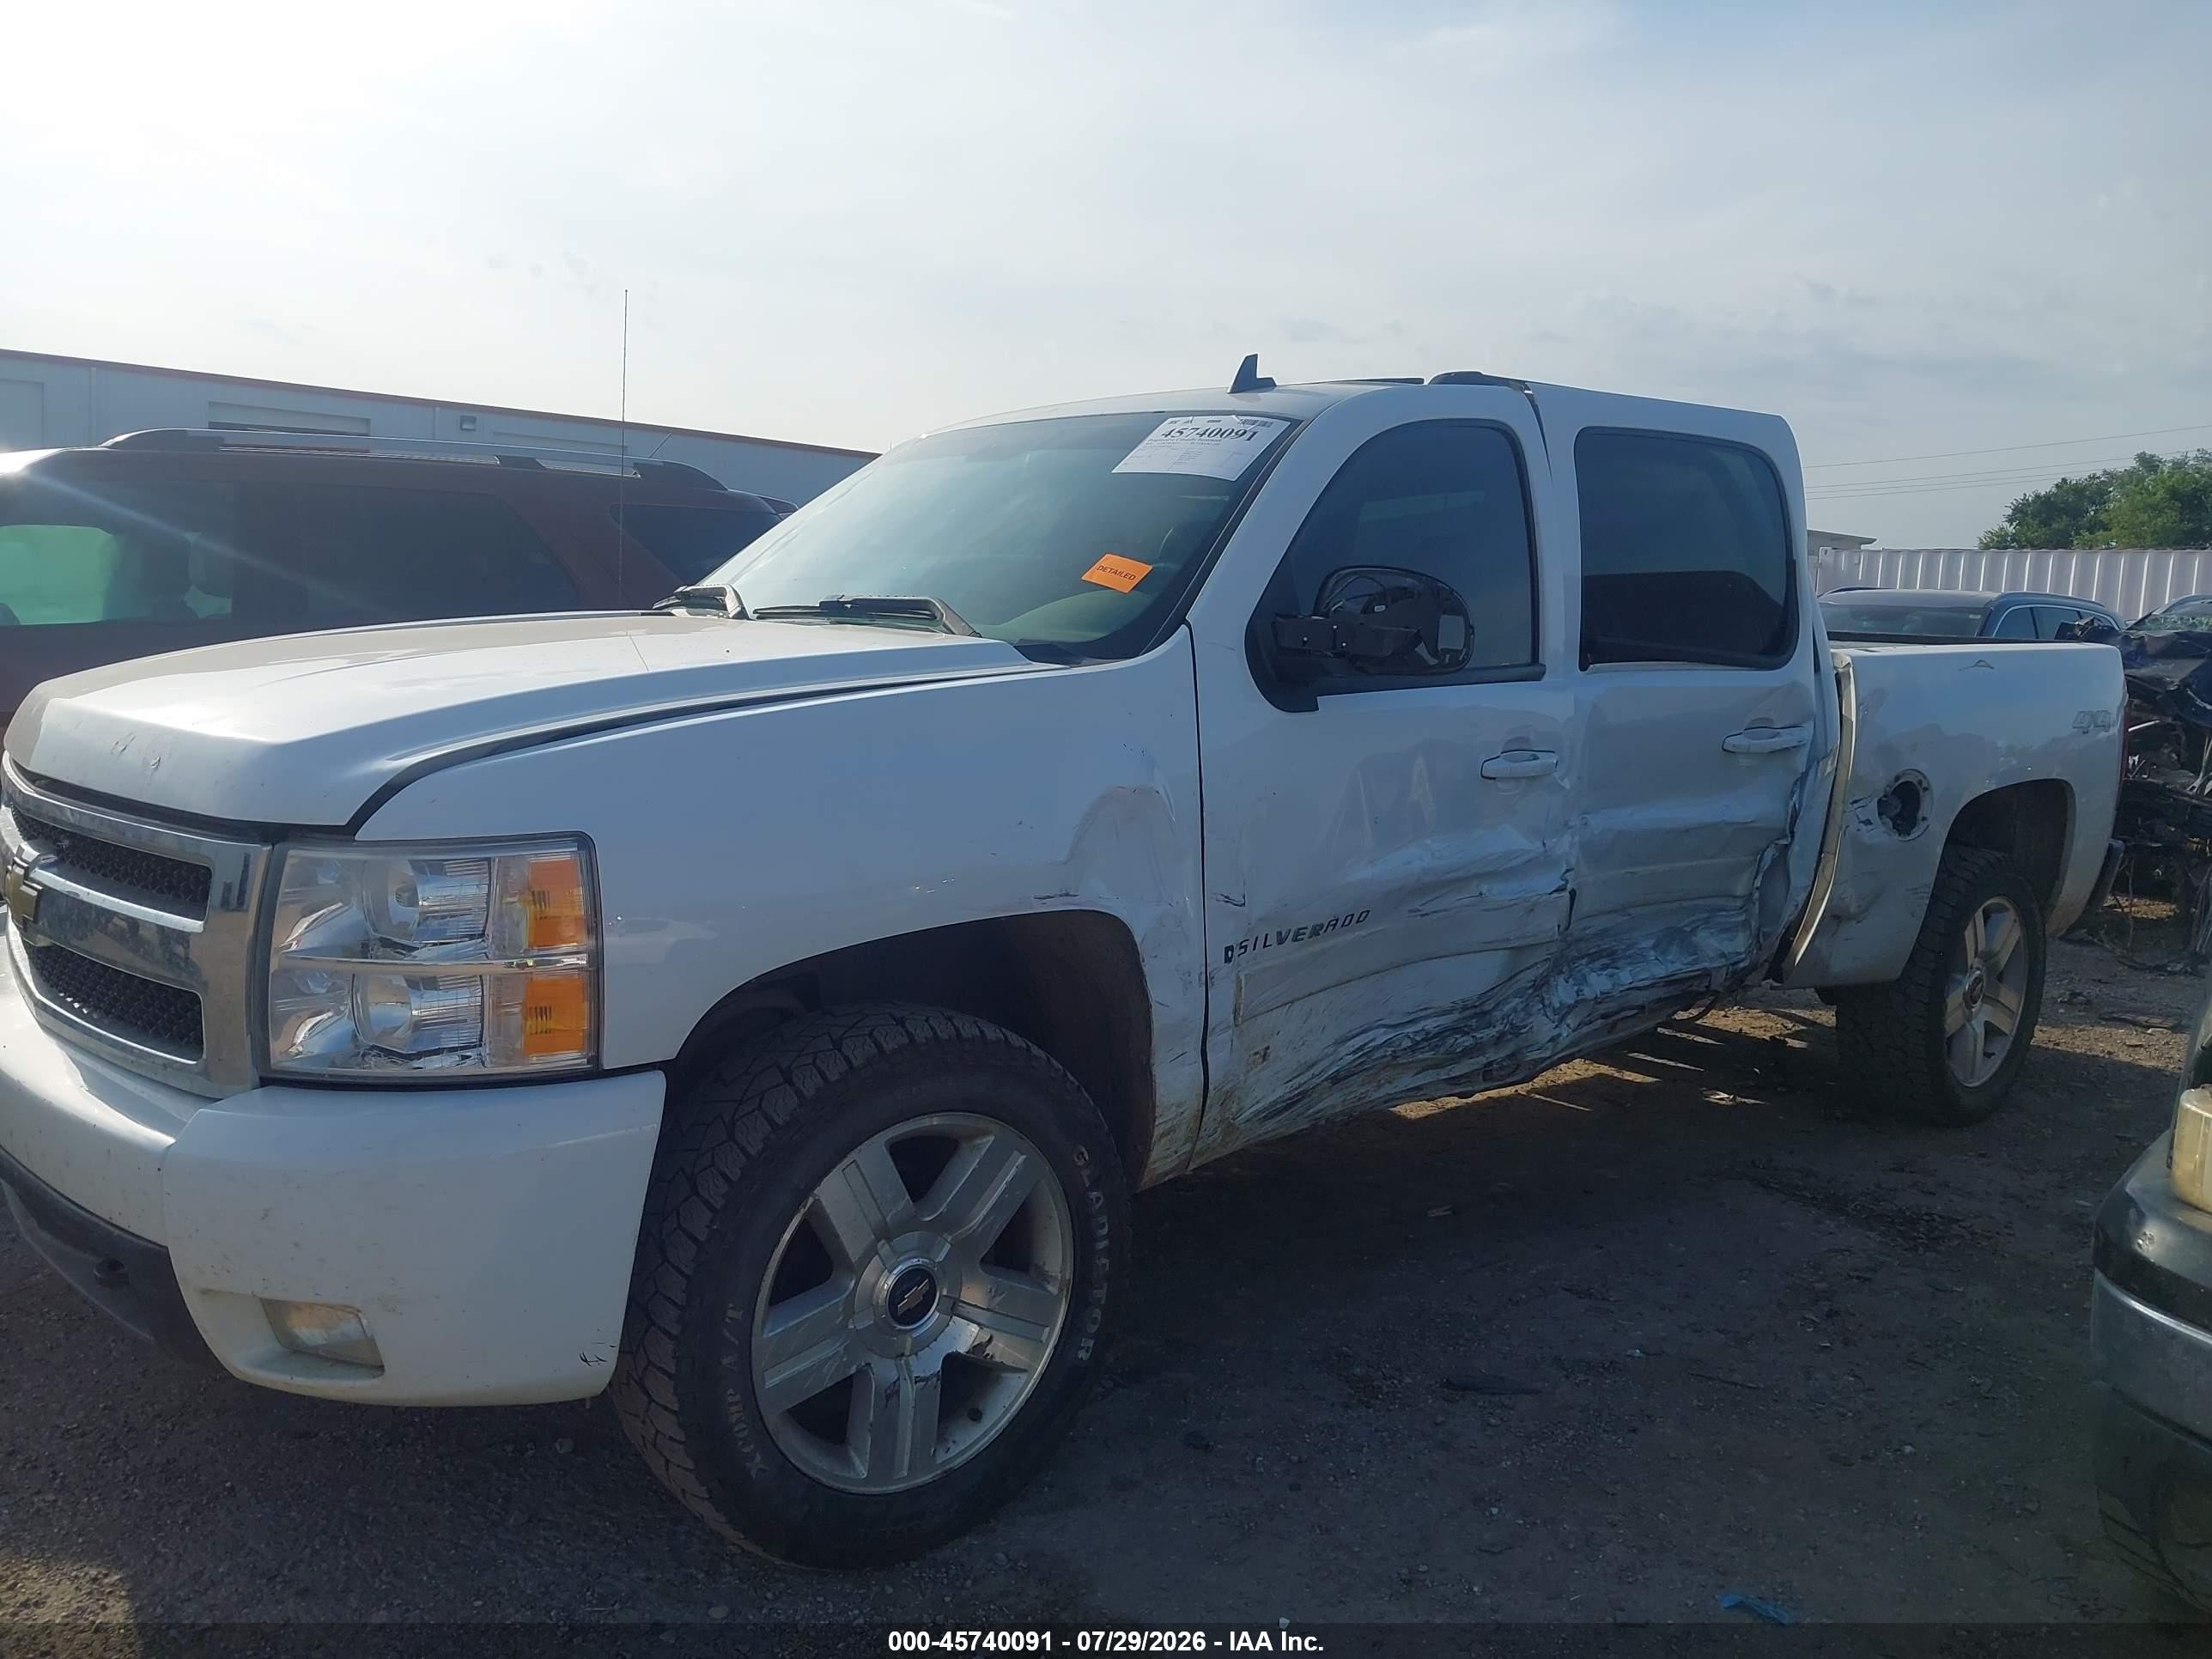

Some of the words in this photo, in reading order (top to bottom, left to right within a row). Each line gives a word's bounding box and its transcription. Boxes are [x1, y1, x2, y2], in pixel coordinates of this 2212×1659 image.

[1161, 426, 1260, 441] 45740091
[1096, 564, 1137, 581] DETAILED
[1237, 909, 1371, 957] SILVERADO
[1073, 1143, 1109, 1362] GLADIATOR
